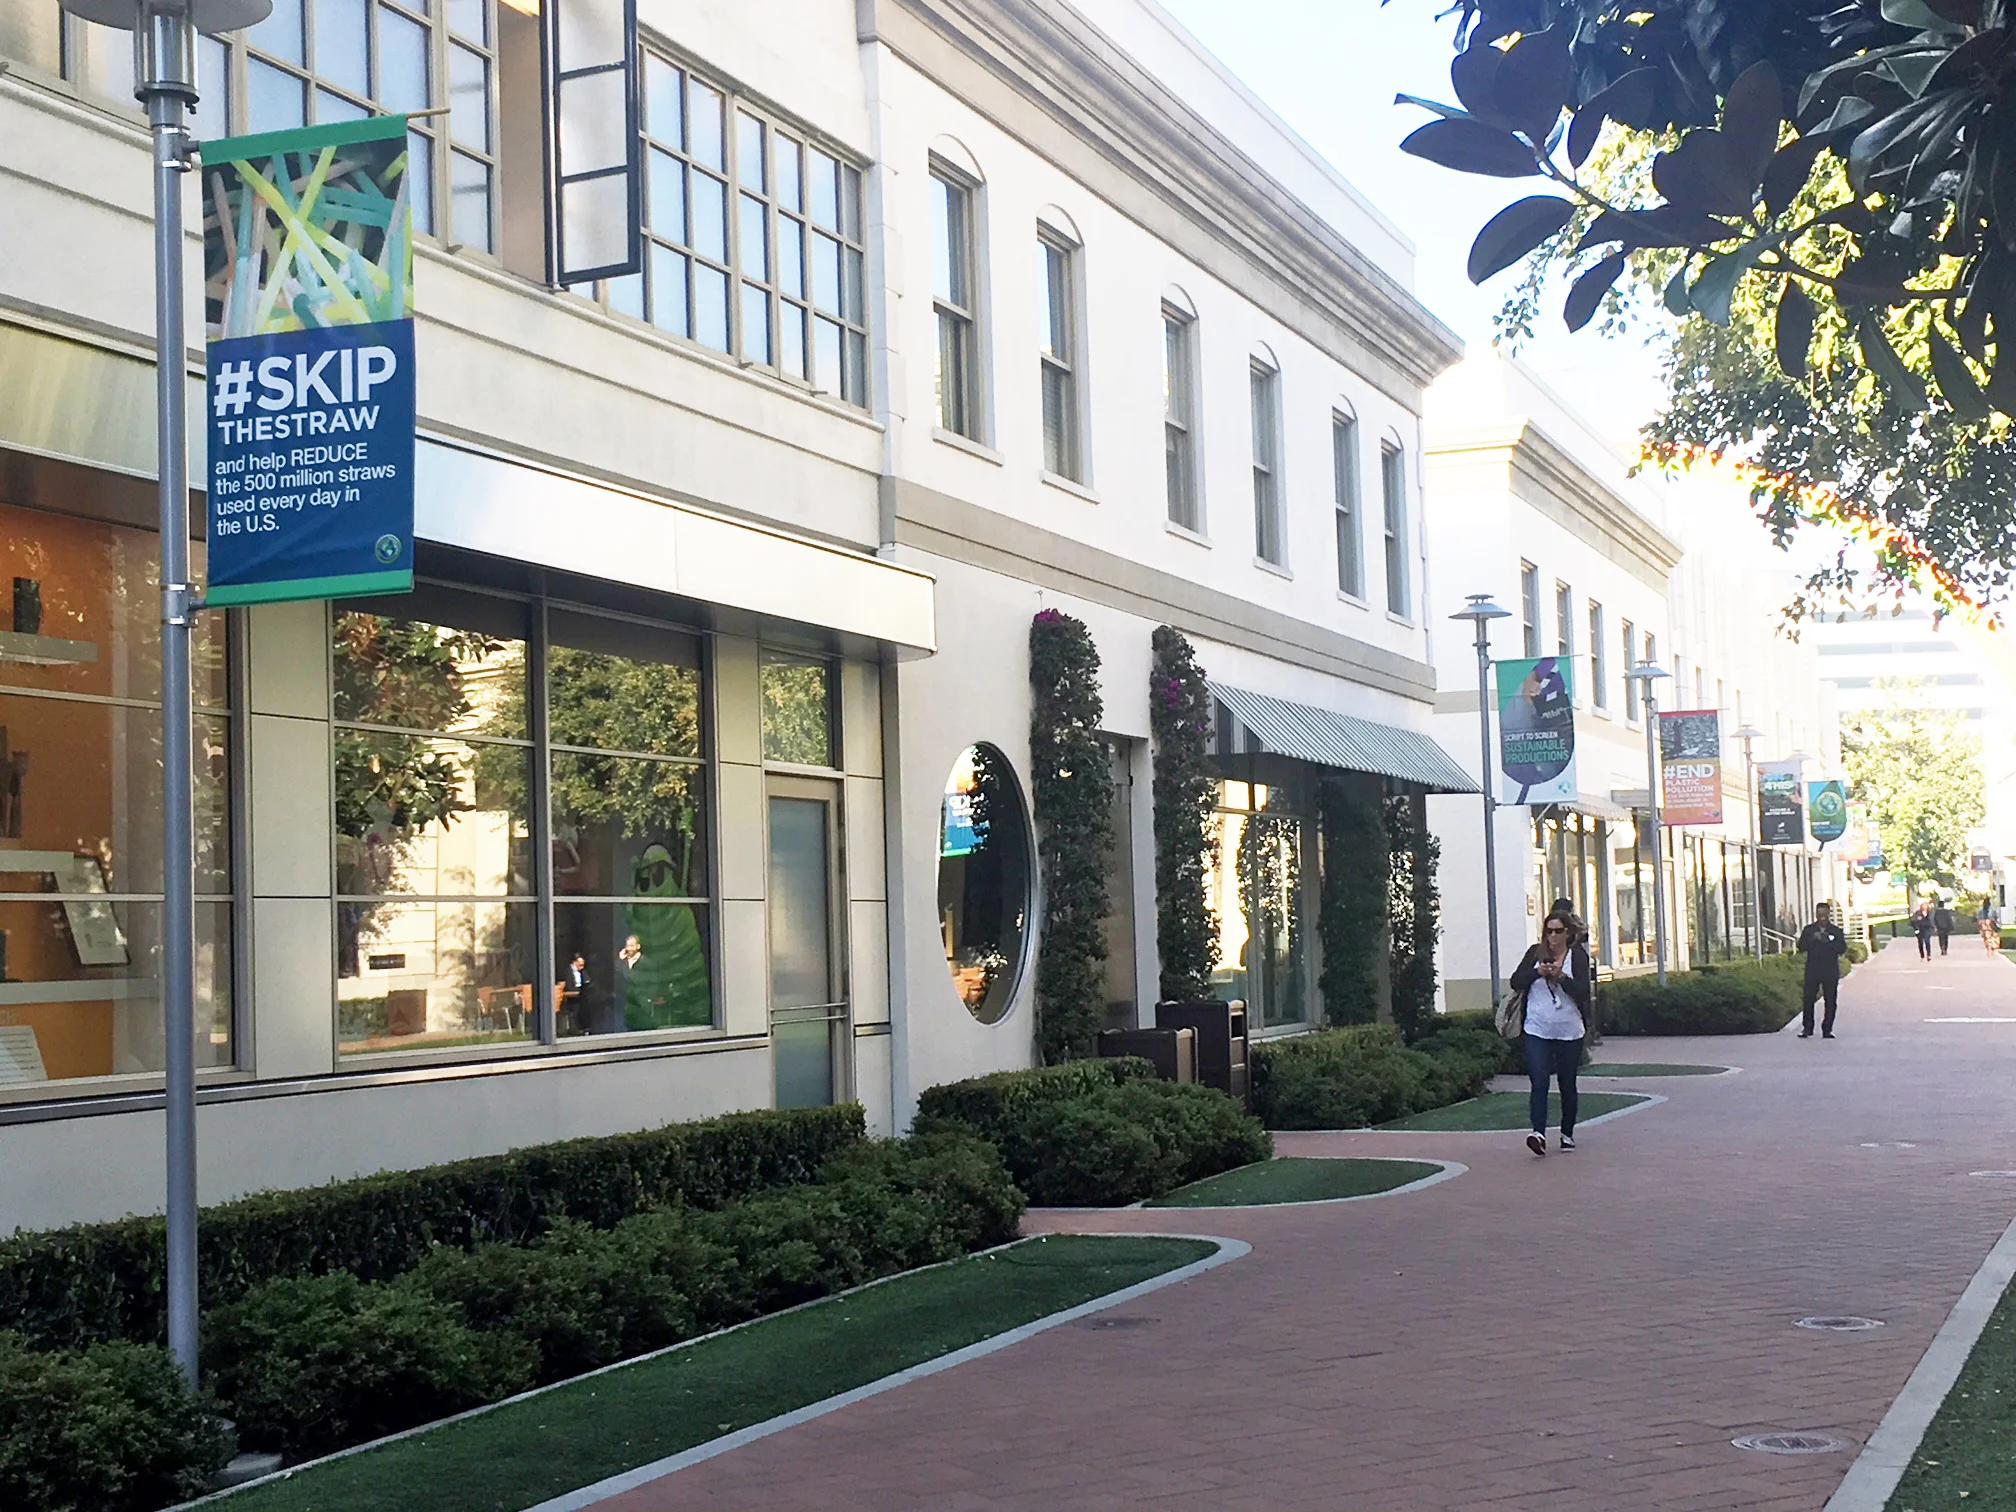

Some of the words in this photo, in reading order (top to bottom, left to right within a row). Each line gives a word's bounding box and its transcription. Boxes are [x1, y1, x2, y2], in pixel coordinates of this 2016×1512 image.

[214, 345, 397, 416] #SKIP
[217, 405, 380, 445] THESTRAW
[215, 455, 246, 475] and
[249, 452, 286, 473] help
[291, 443, 367, 467] REDUCE
[216, 478, 241, 495] the
[244, 473, 276, 492] 500
[280, 468, 334, 488] million
[338, 463, 396, 482] straws
[217, 496, 255, 516] used
[262, 493, 306, 512] every
[309, 487, 342, 508] day
[345, 486, 360, 501] in
[217, 519, 241, 536] the
[245, 513, 280, 533] U.S.
[1504, 739, 1566, 752] SUSTAINABLE
[1525, 732, 1534, 740] TO
[1505, 750, 1569, 763] PRODUCTIONS
[1663, 764, 1714, 779] #END
[1665, 778, 1700, 786] PLASTIC
[1665, 785, 1714, 793] POLLUTION
